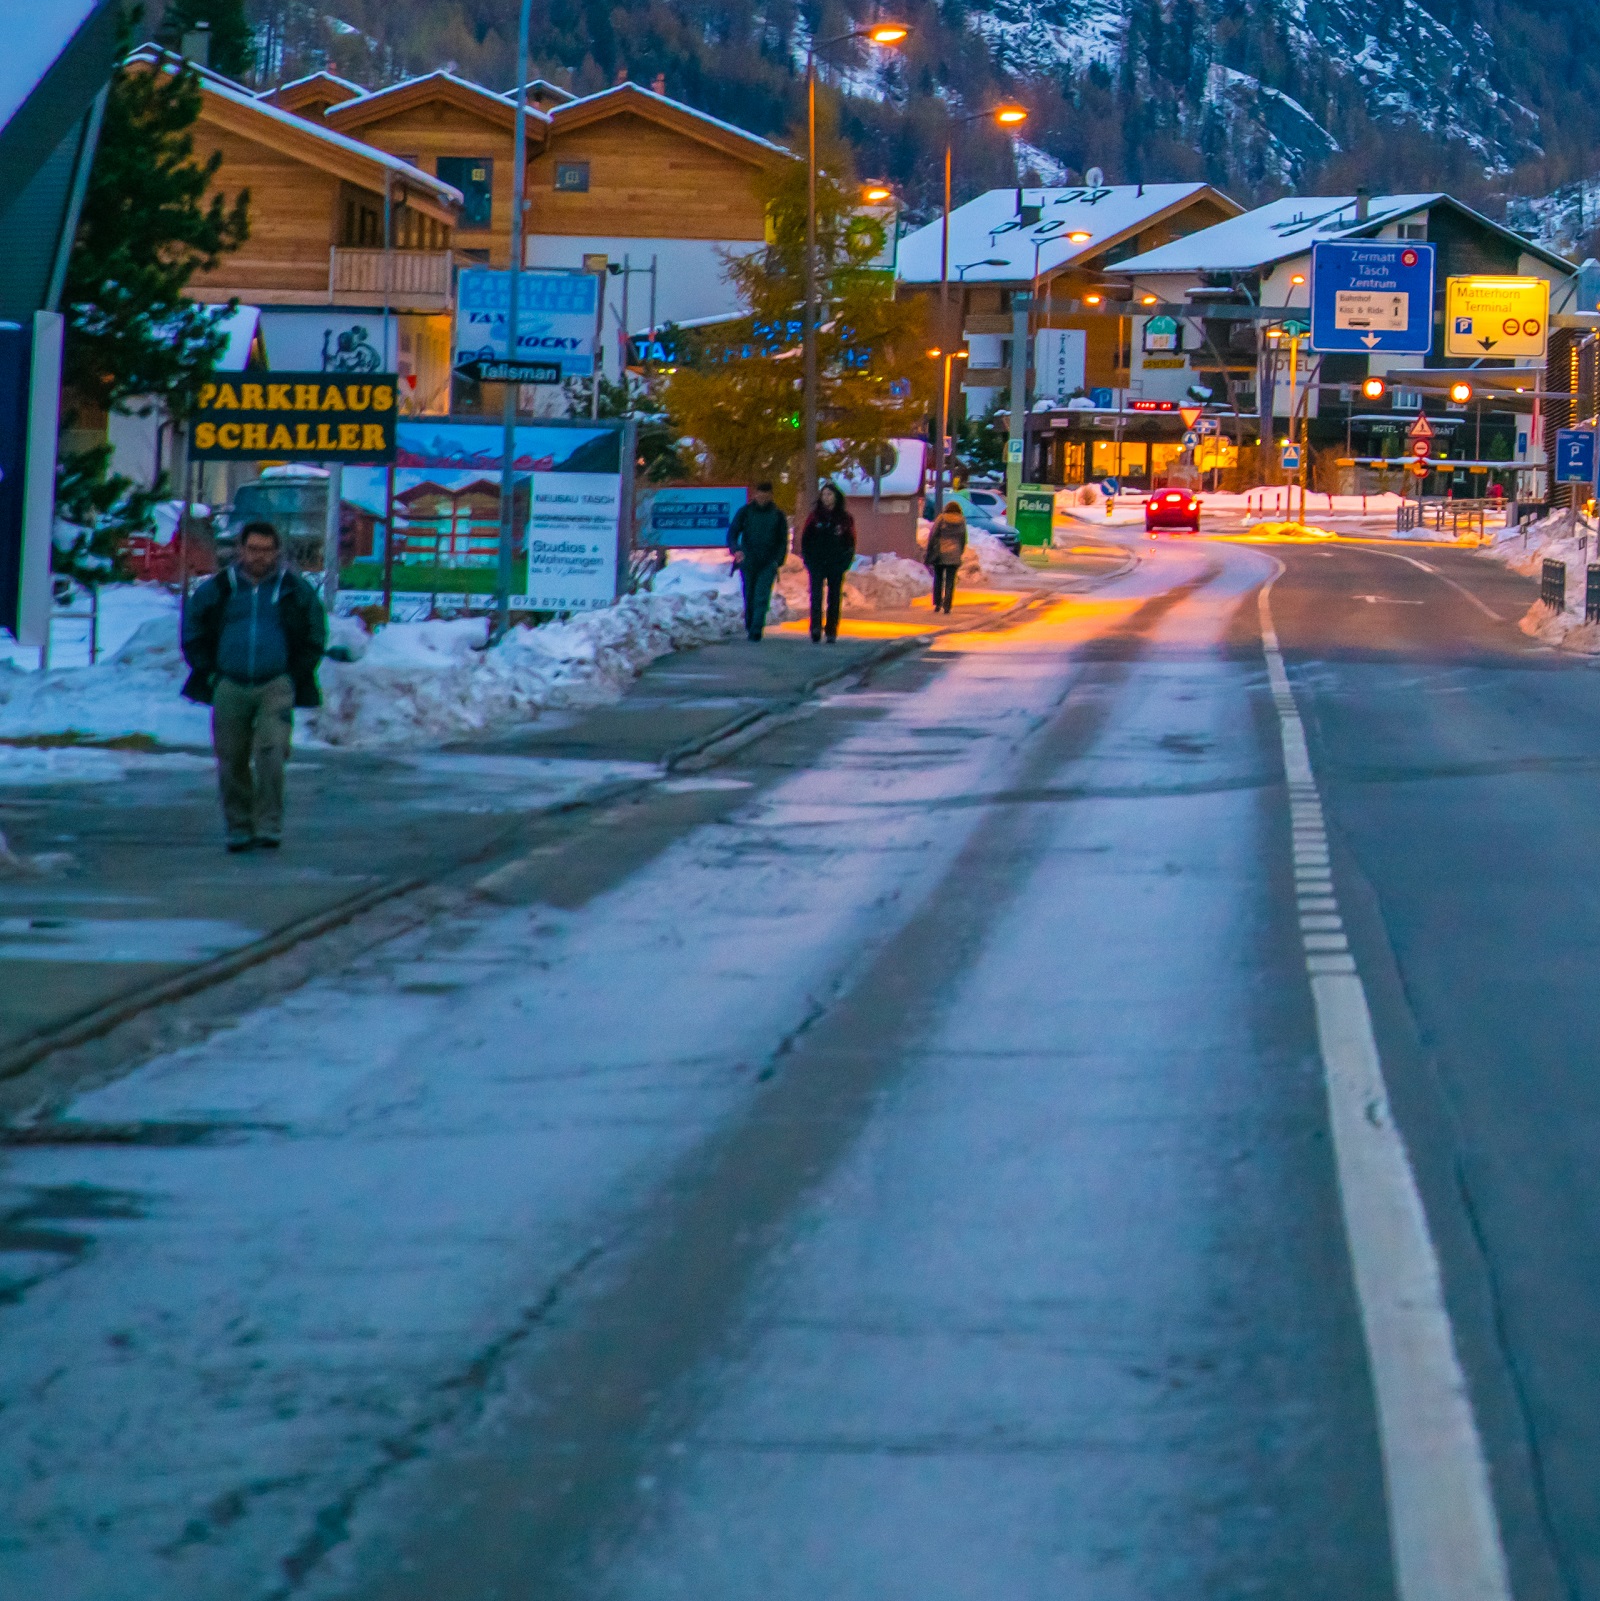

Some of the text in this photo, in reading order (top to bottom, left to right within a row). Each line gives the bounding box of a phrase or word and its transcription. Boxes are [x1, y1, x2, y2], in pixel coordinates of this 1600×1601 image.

[1351, 251, 1396, 262] Zermatt
[1349, 277, 1397, 288] Zentrum
[1457, 287, 1521, 299] Matterhorn
[1465, 301, 1513, 313] Terminal
[477, 362, 557, 380] Talisman
[199, 383, 393, 411] PARKHAUS
[195, 422, 387, 450] SCHALLER
[1019, 499, 1050, 512] Reka
[533, 540, 586, 553] Studios
[533, 555, 604, 567] Wohnungen
